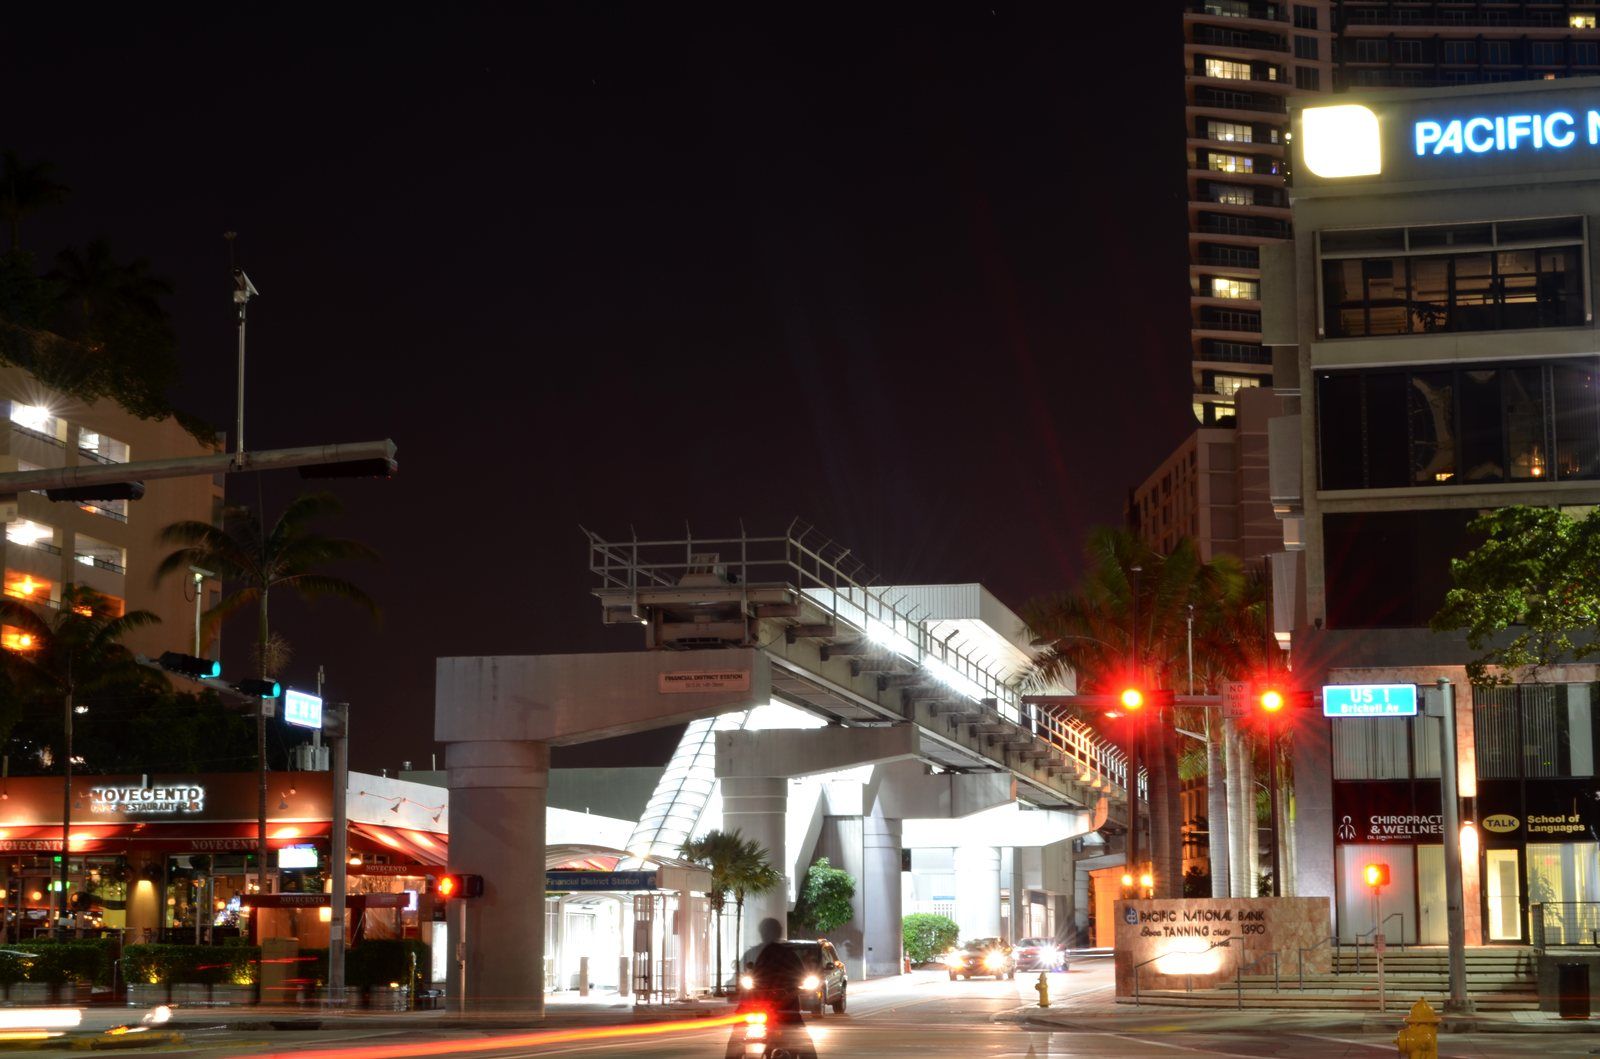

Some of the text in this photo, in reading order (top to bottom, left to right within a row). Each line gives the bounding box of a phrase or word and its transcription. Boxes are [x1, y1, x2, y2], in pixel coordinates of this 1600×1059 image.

[1415, 112, 1575, 156] PACIFIC
[664, 674, 693, 682] FINANCIAL
[1230, 684, 1243, 692] NO
[1350, 688, 1390, 703] US 1
[1341, 703, 1399, 714] Brickell Av
[92, 787, 201, 801] NOVECENTO
[1488, 819, 1515, 828] TALK
[1527, 814, 1580, 824] School of
[1371, 825, 1380, 834] &
[1527, 823, 1585, 834] Languages
[546, 877, 640, 886] Financial District Station
[280, 896, 325, 904] NOVECENTO
[1140, 909, 1265, 922] PACIFIC NATIONAL BANK
[1163, 925, 1210, 937] TANNING
[1212, 928, 1231, 936] club
[1240, 924, 1266, 935] 1390
